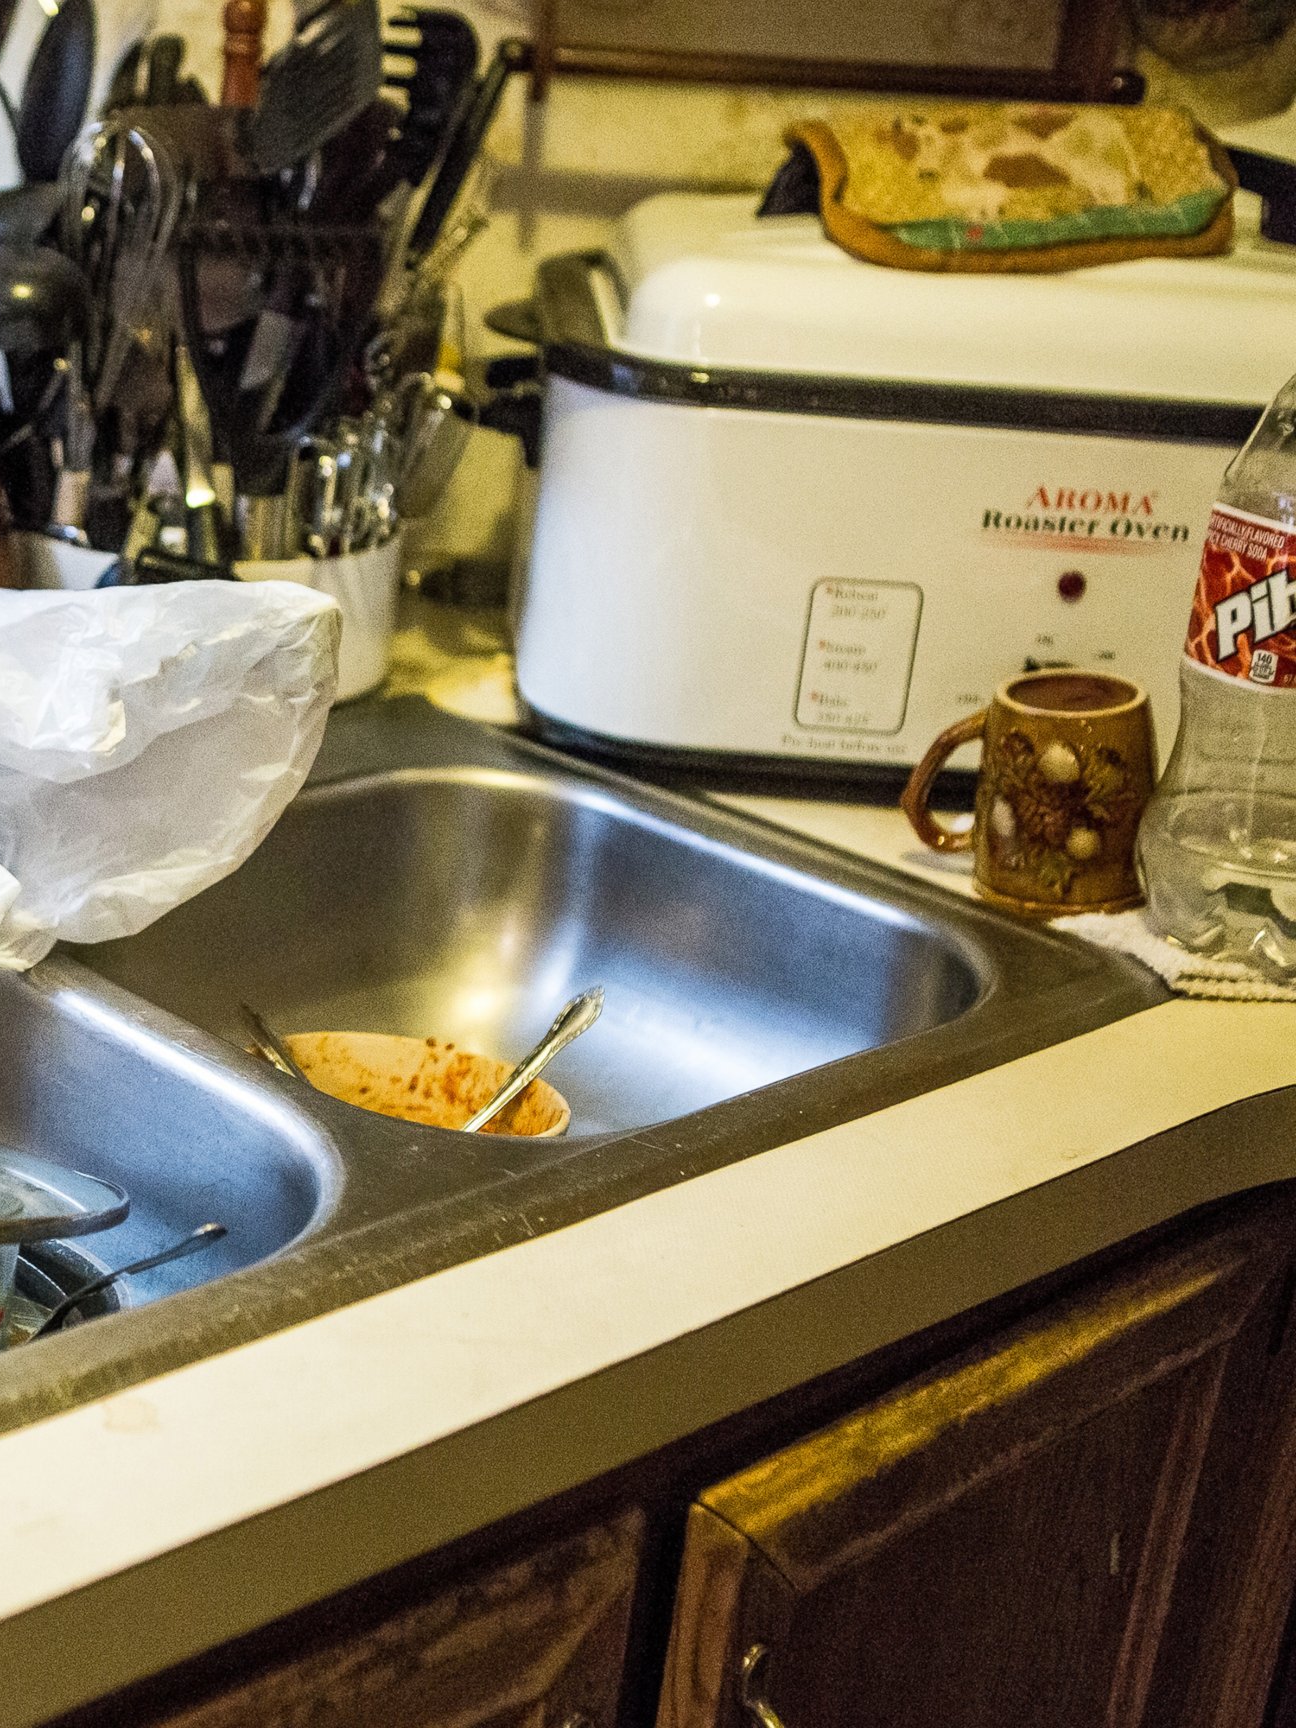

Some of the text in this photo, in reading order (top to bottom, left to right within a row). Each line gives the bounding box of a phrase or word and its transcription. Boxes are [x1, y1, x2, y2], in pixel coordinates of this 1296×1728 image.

[1026, 486, 1154, 517] AROMA
[982, 508, 1190, 543] Roaster Oven
[1247, 542, 1268, 561] SODA
